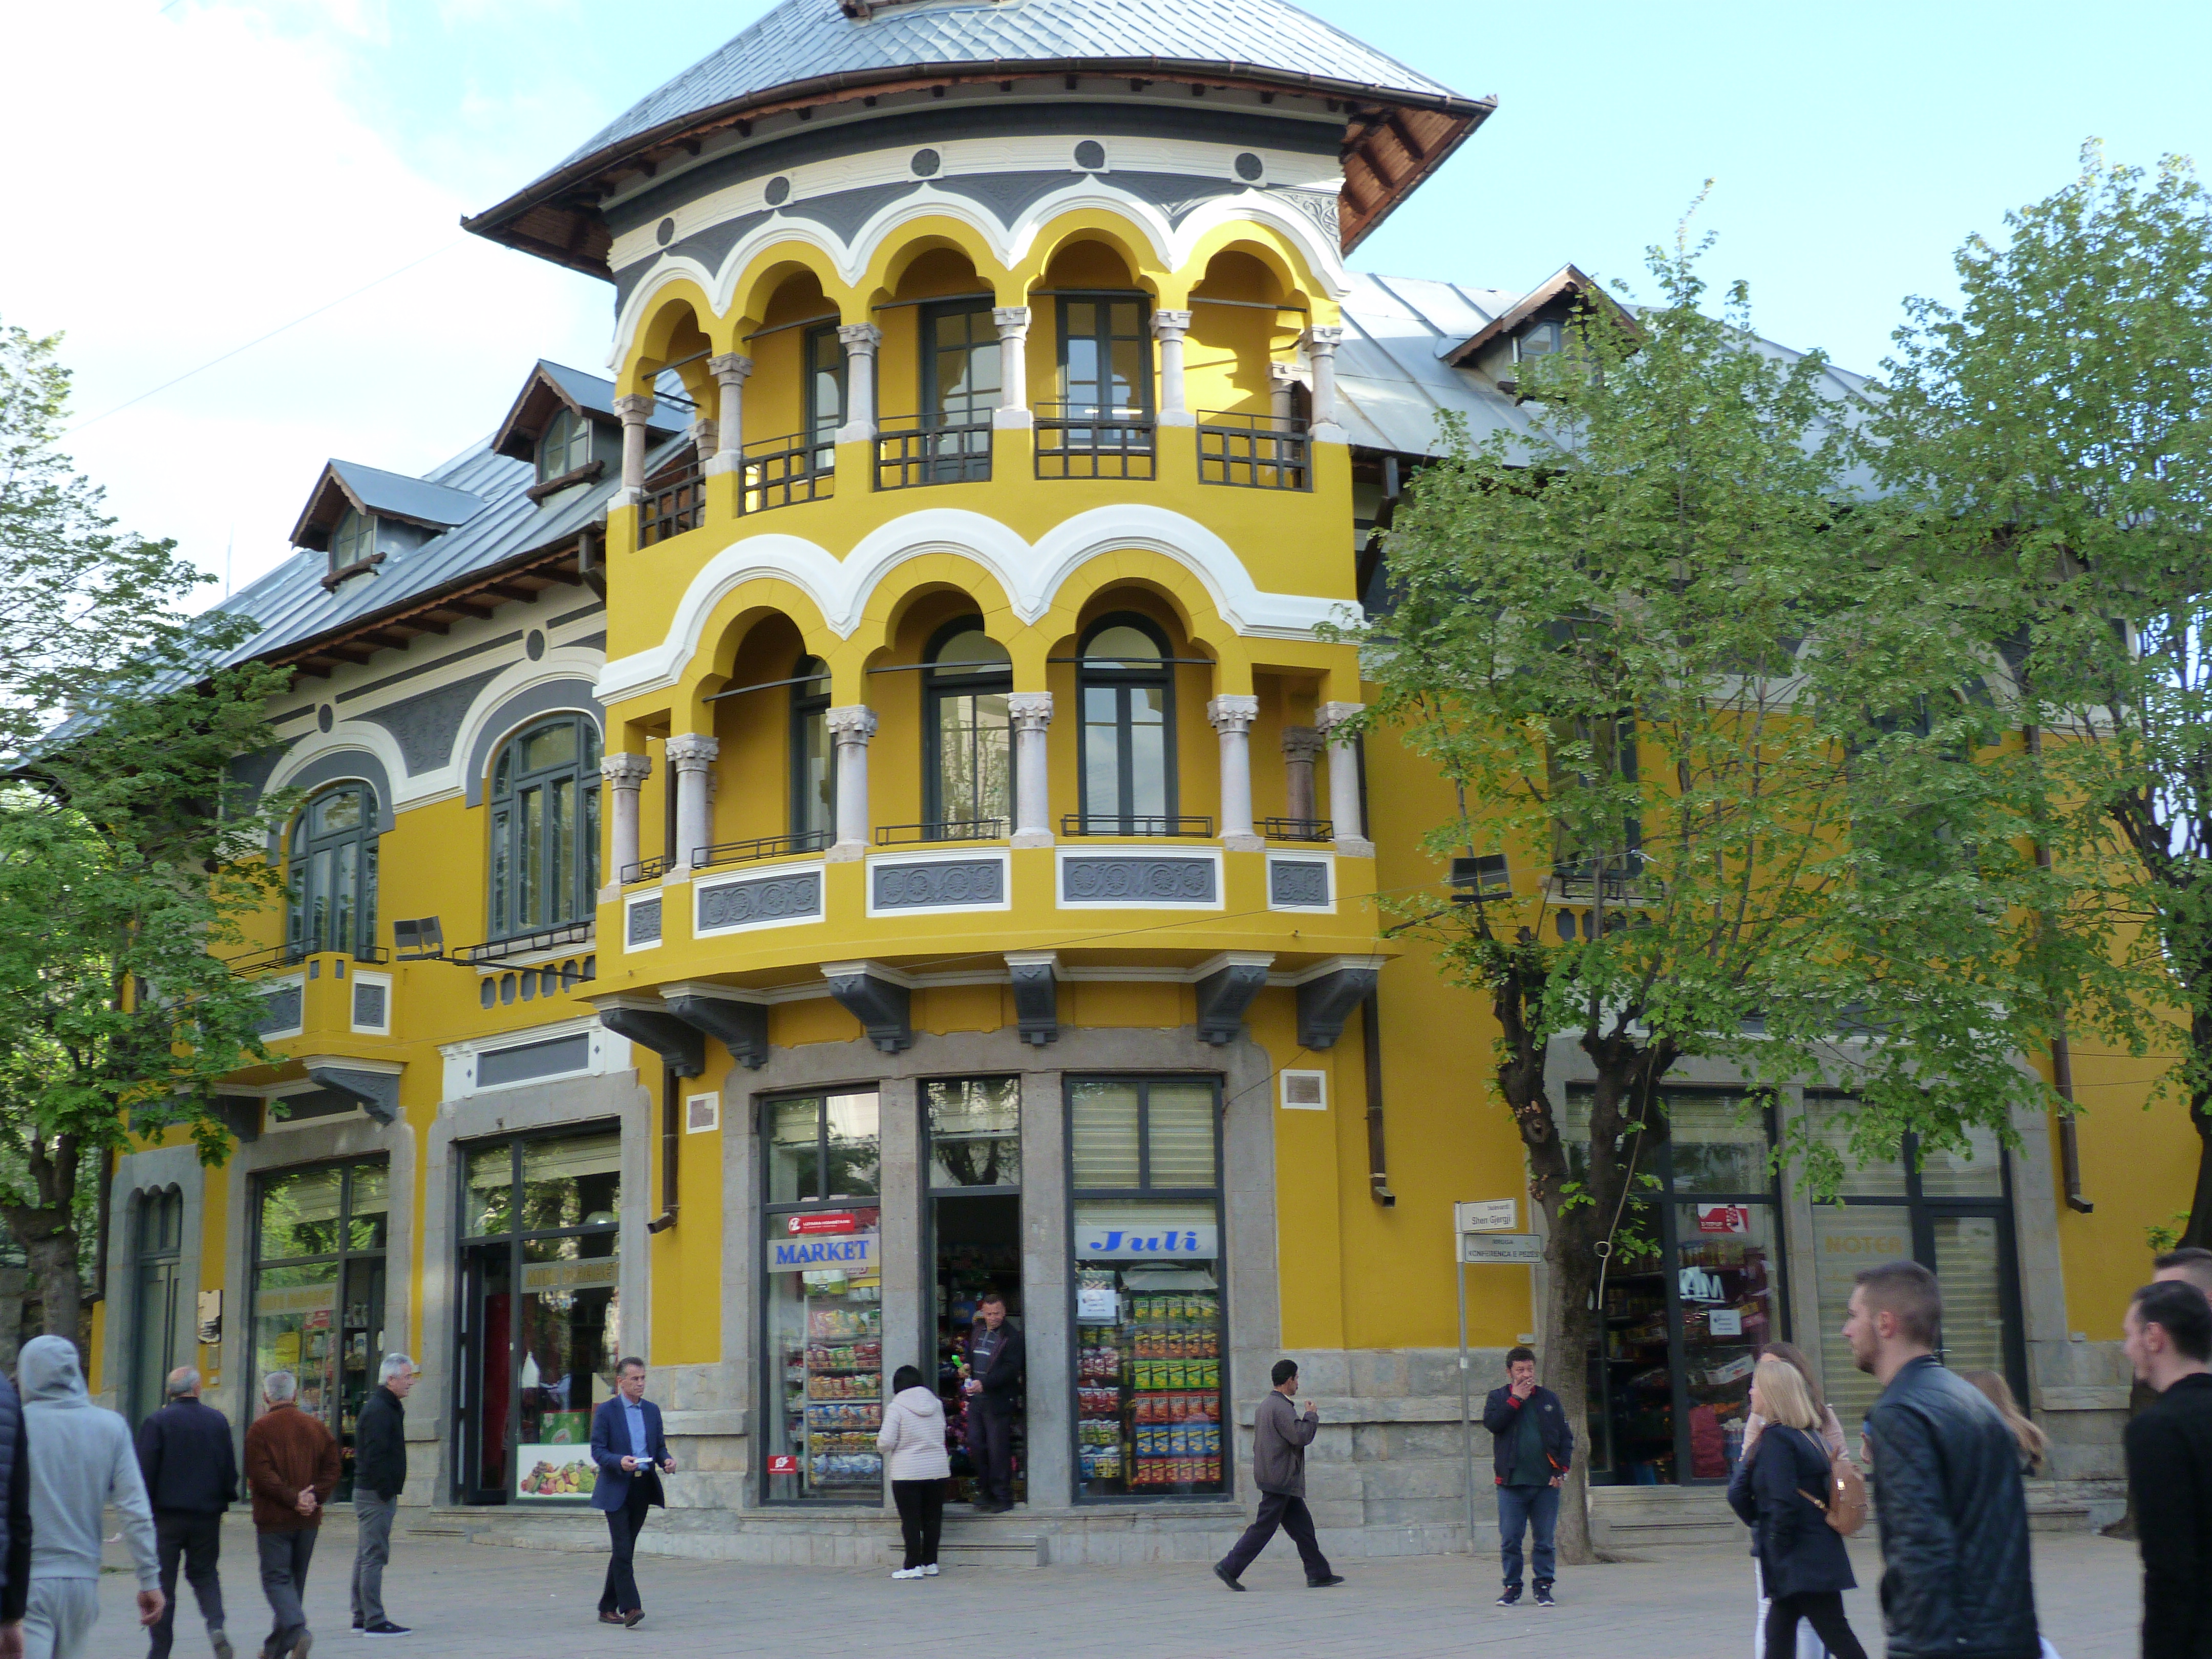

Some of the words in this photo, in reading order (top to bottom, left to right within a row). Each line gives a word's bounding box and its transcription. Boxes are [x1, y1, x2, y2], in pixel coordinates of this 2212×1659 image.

[1490, 1214, 1512, 1225] Gjergji
[1089, 1230, 1201, 1252] Juli
[1824, 1235, 1902, 1253] NOTER
[776, 1241, 868, 1264] MARKET
